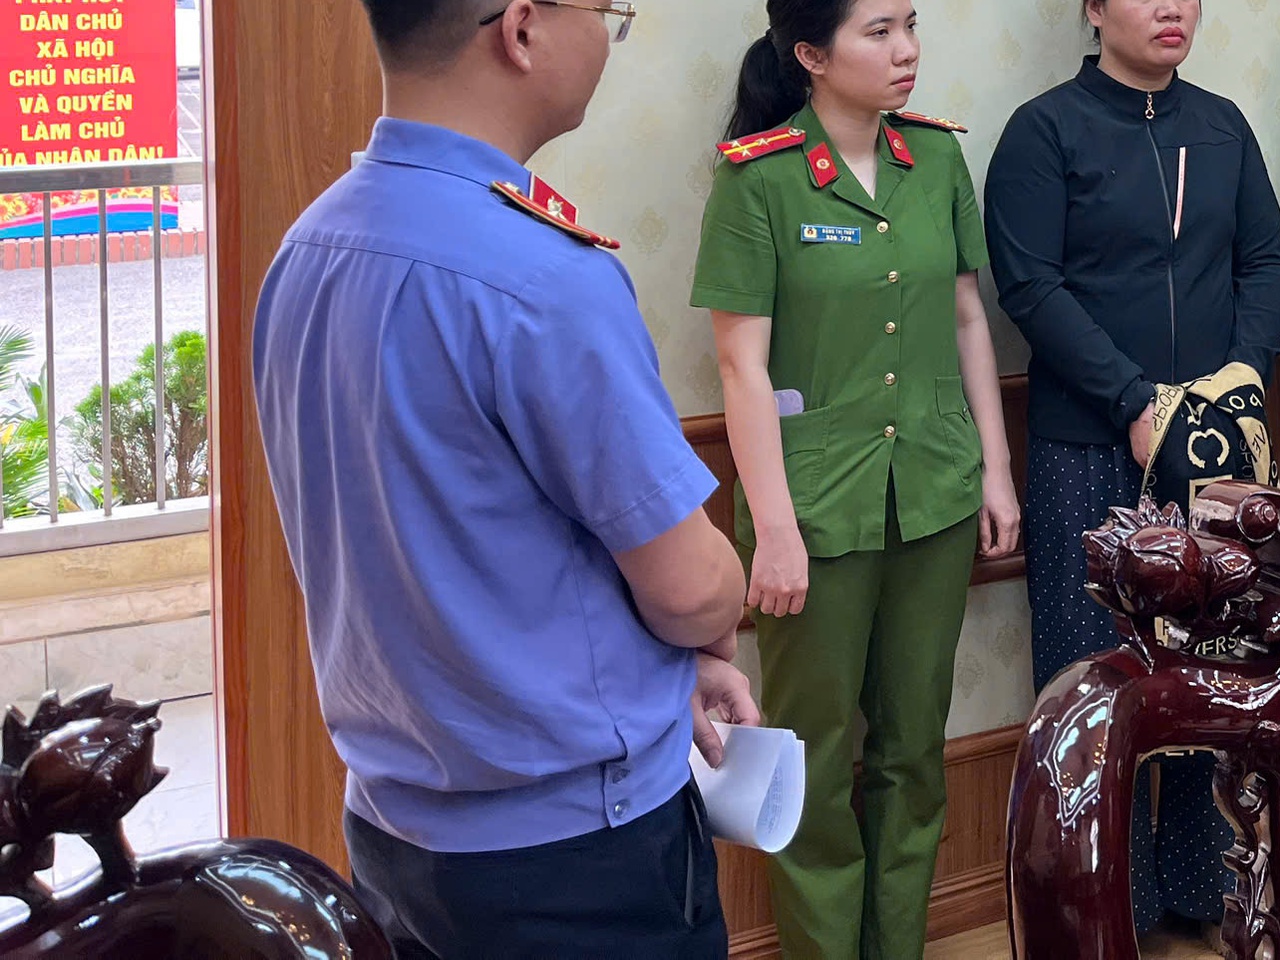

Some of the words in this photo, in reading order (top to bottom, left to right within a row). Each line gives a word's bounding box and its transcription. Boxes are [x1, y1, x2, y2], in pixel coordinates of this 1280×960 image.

[20, 11, 69, 31] DÂN
[76, 8, 123, 30] CHỦ
[37, 39, 69, 59] XÃ
[75, 38, 114, 60] HỘI
[9, 63, 57, 86] CHỦ
[64, 63, 136, 86] NGHĨA
[19, 94, 50, 114] VÀ
[57, 89, 133, 113] QUYỀN
[21, 120, 71, 142] LÀM
[79, 117, 125, 140] CHỦ
[0, 148, 28, 167] ỦA
[35, 146, 100, 165] NHÂN
